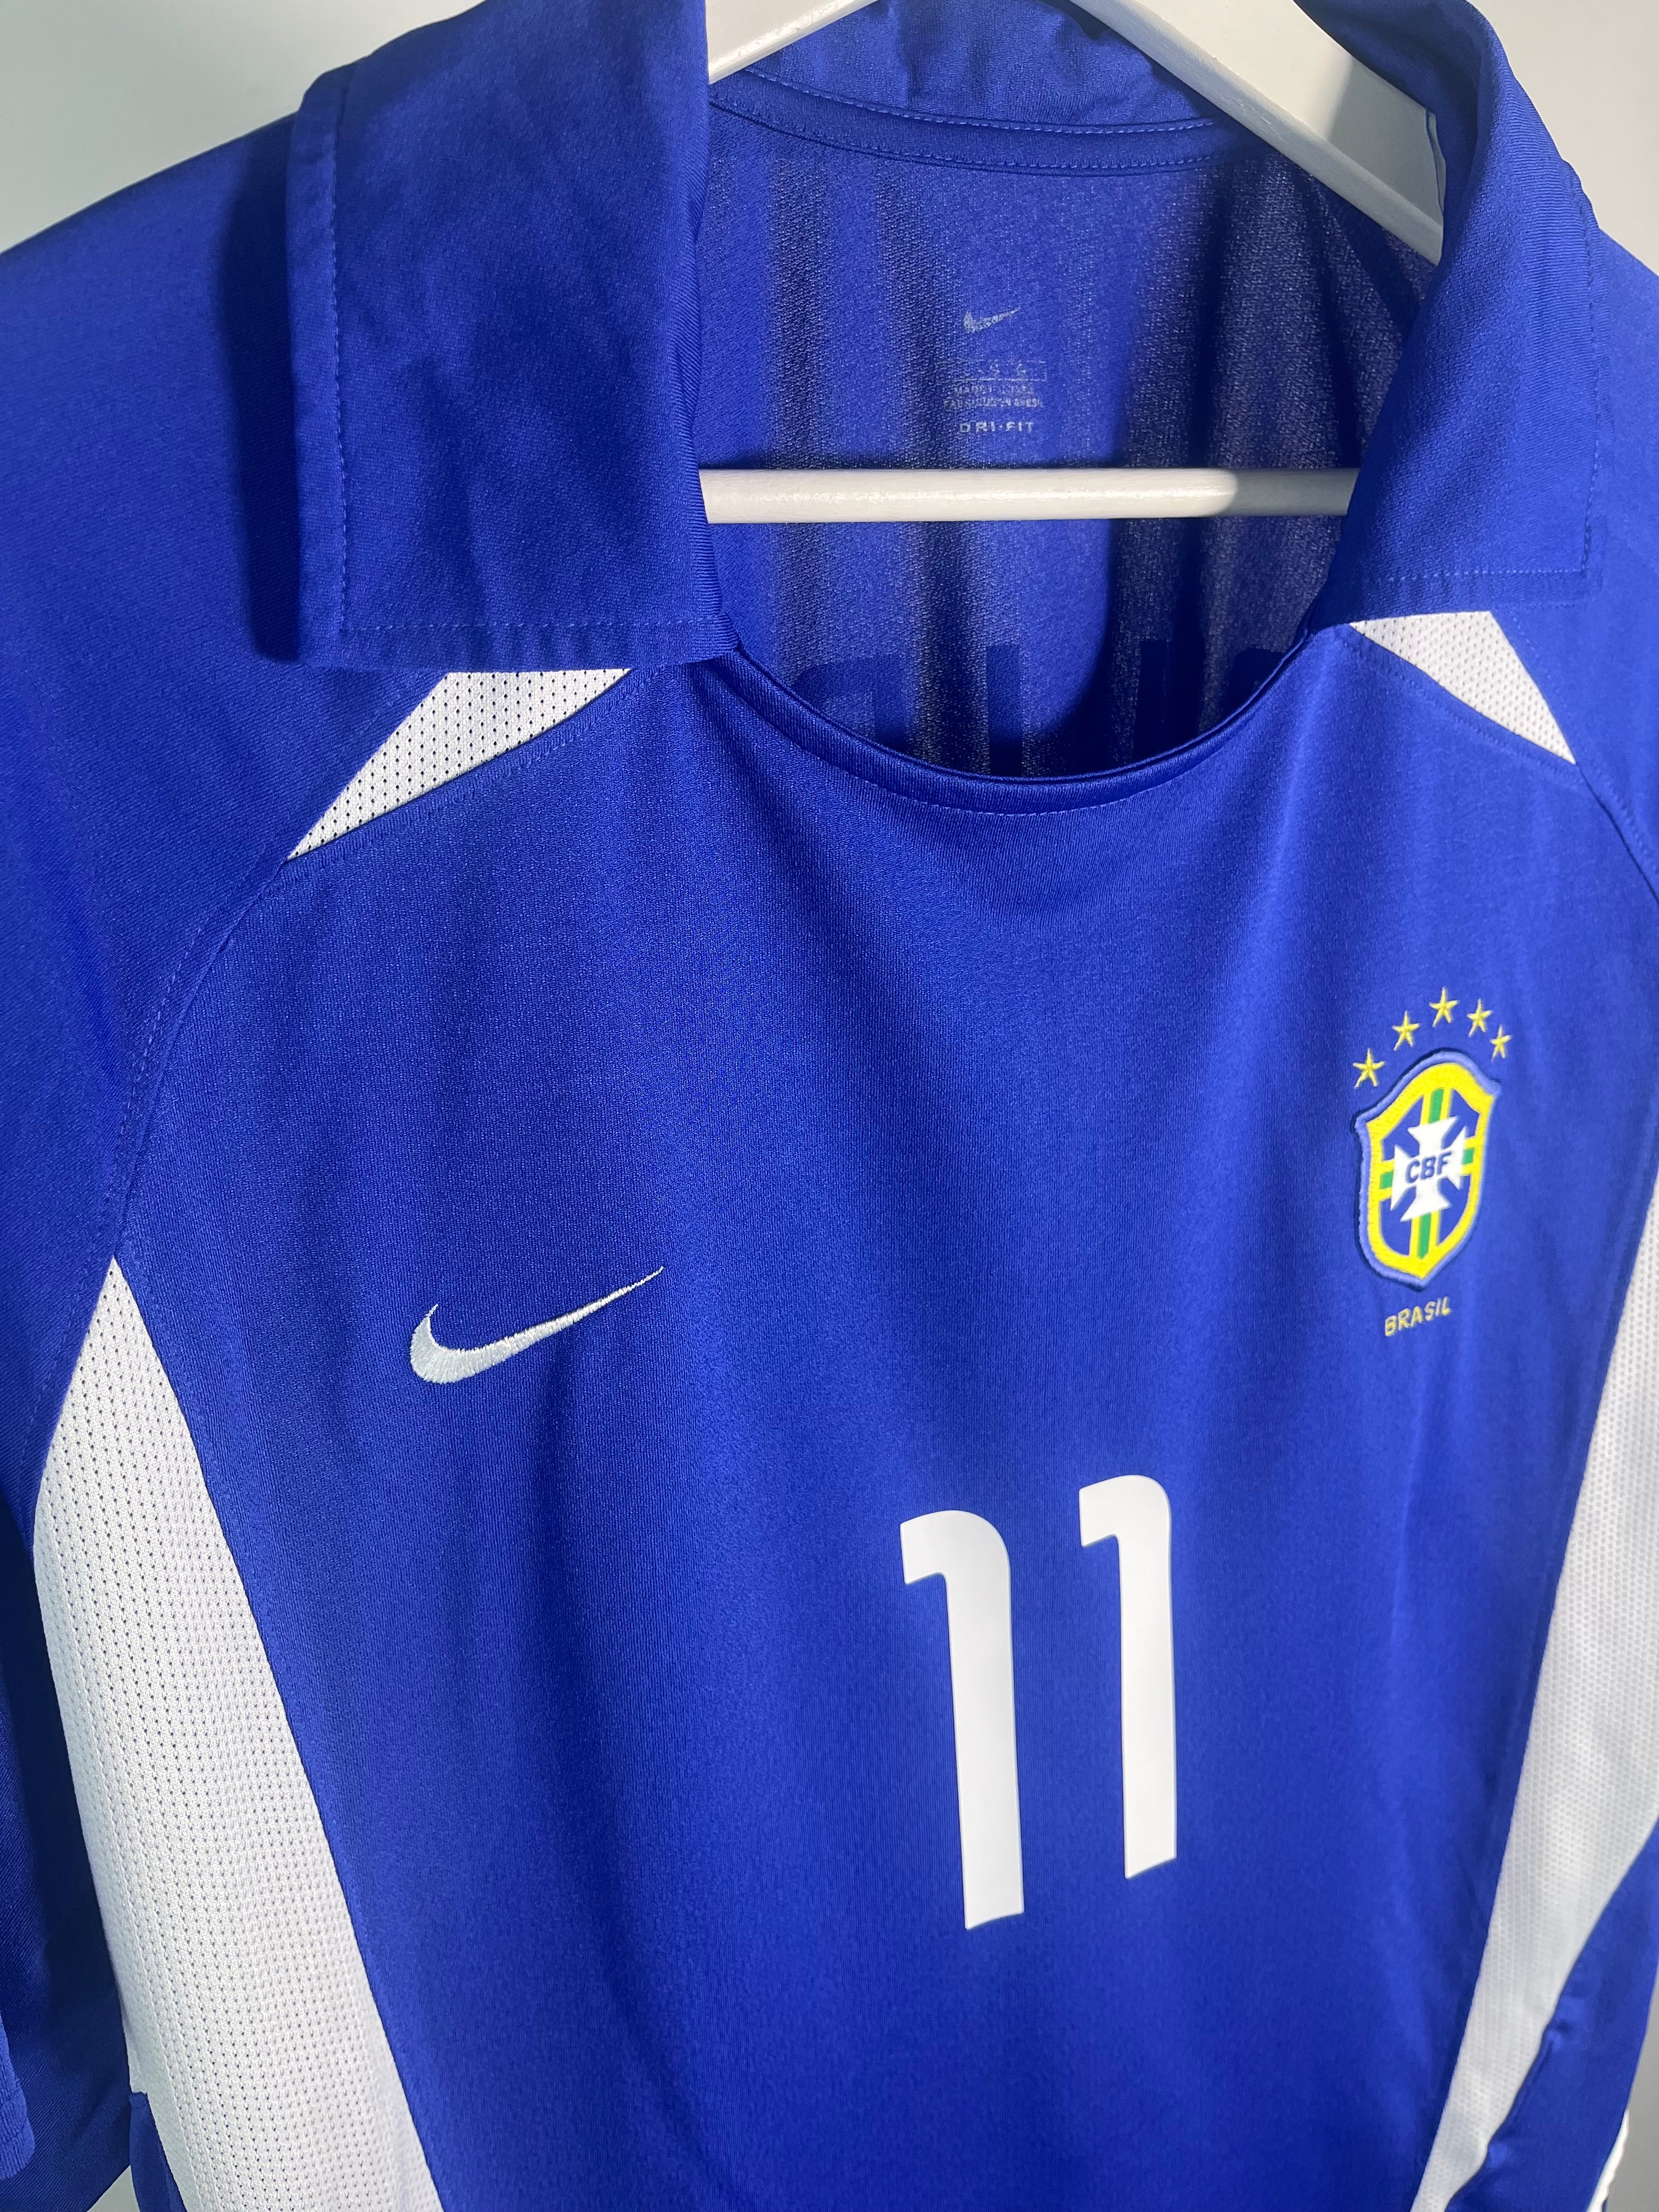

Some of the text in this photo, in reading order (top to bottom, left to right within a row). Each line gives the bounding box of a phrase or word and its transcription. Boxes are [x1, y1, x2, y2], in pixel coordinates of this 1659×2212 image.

[1406, 1150, 1451, 1183] CBF
[1384, 1296, 1451, 1337] BRASIL
[900, 1474, 1177, 1930] 11
